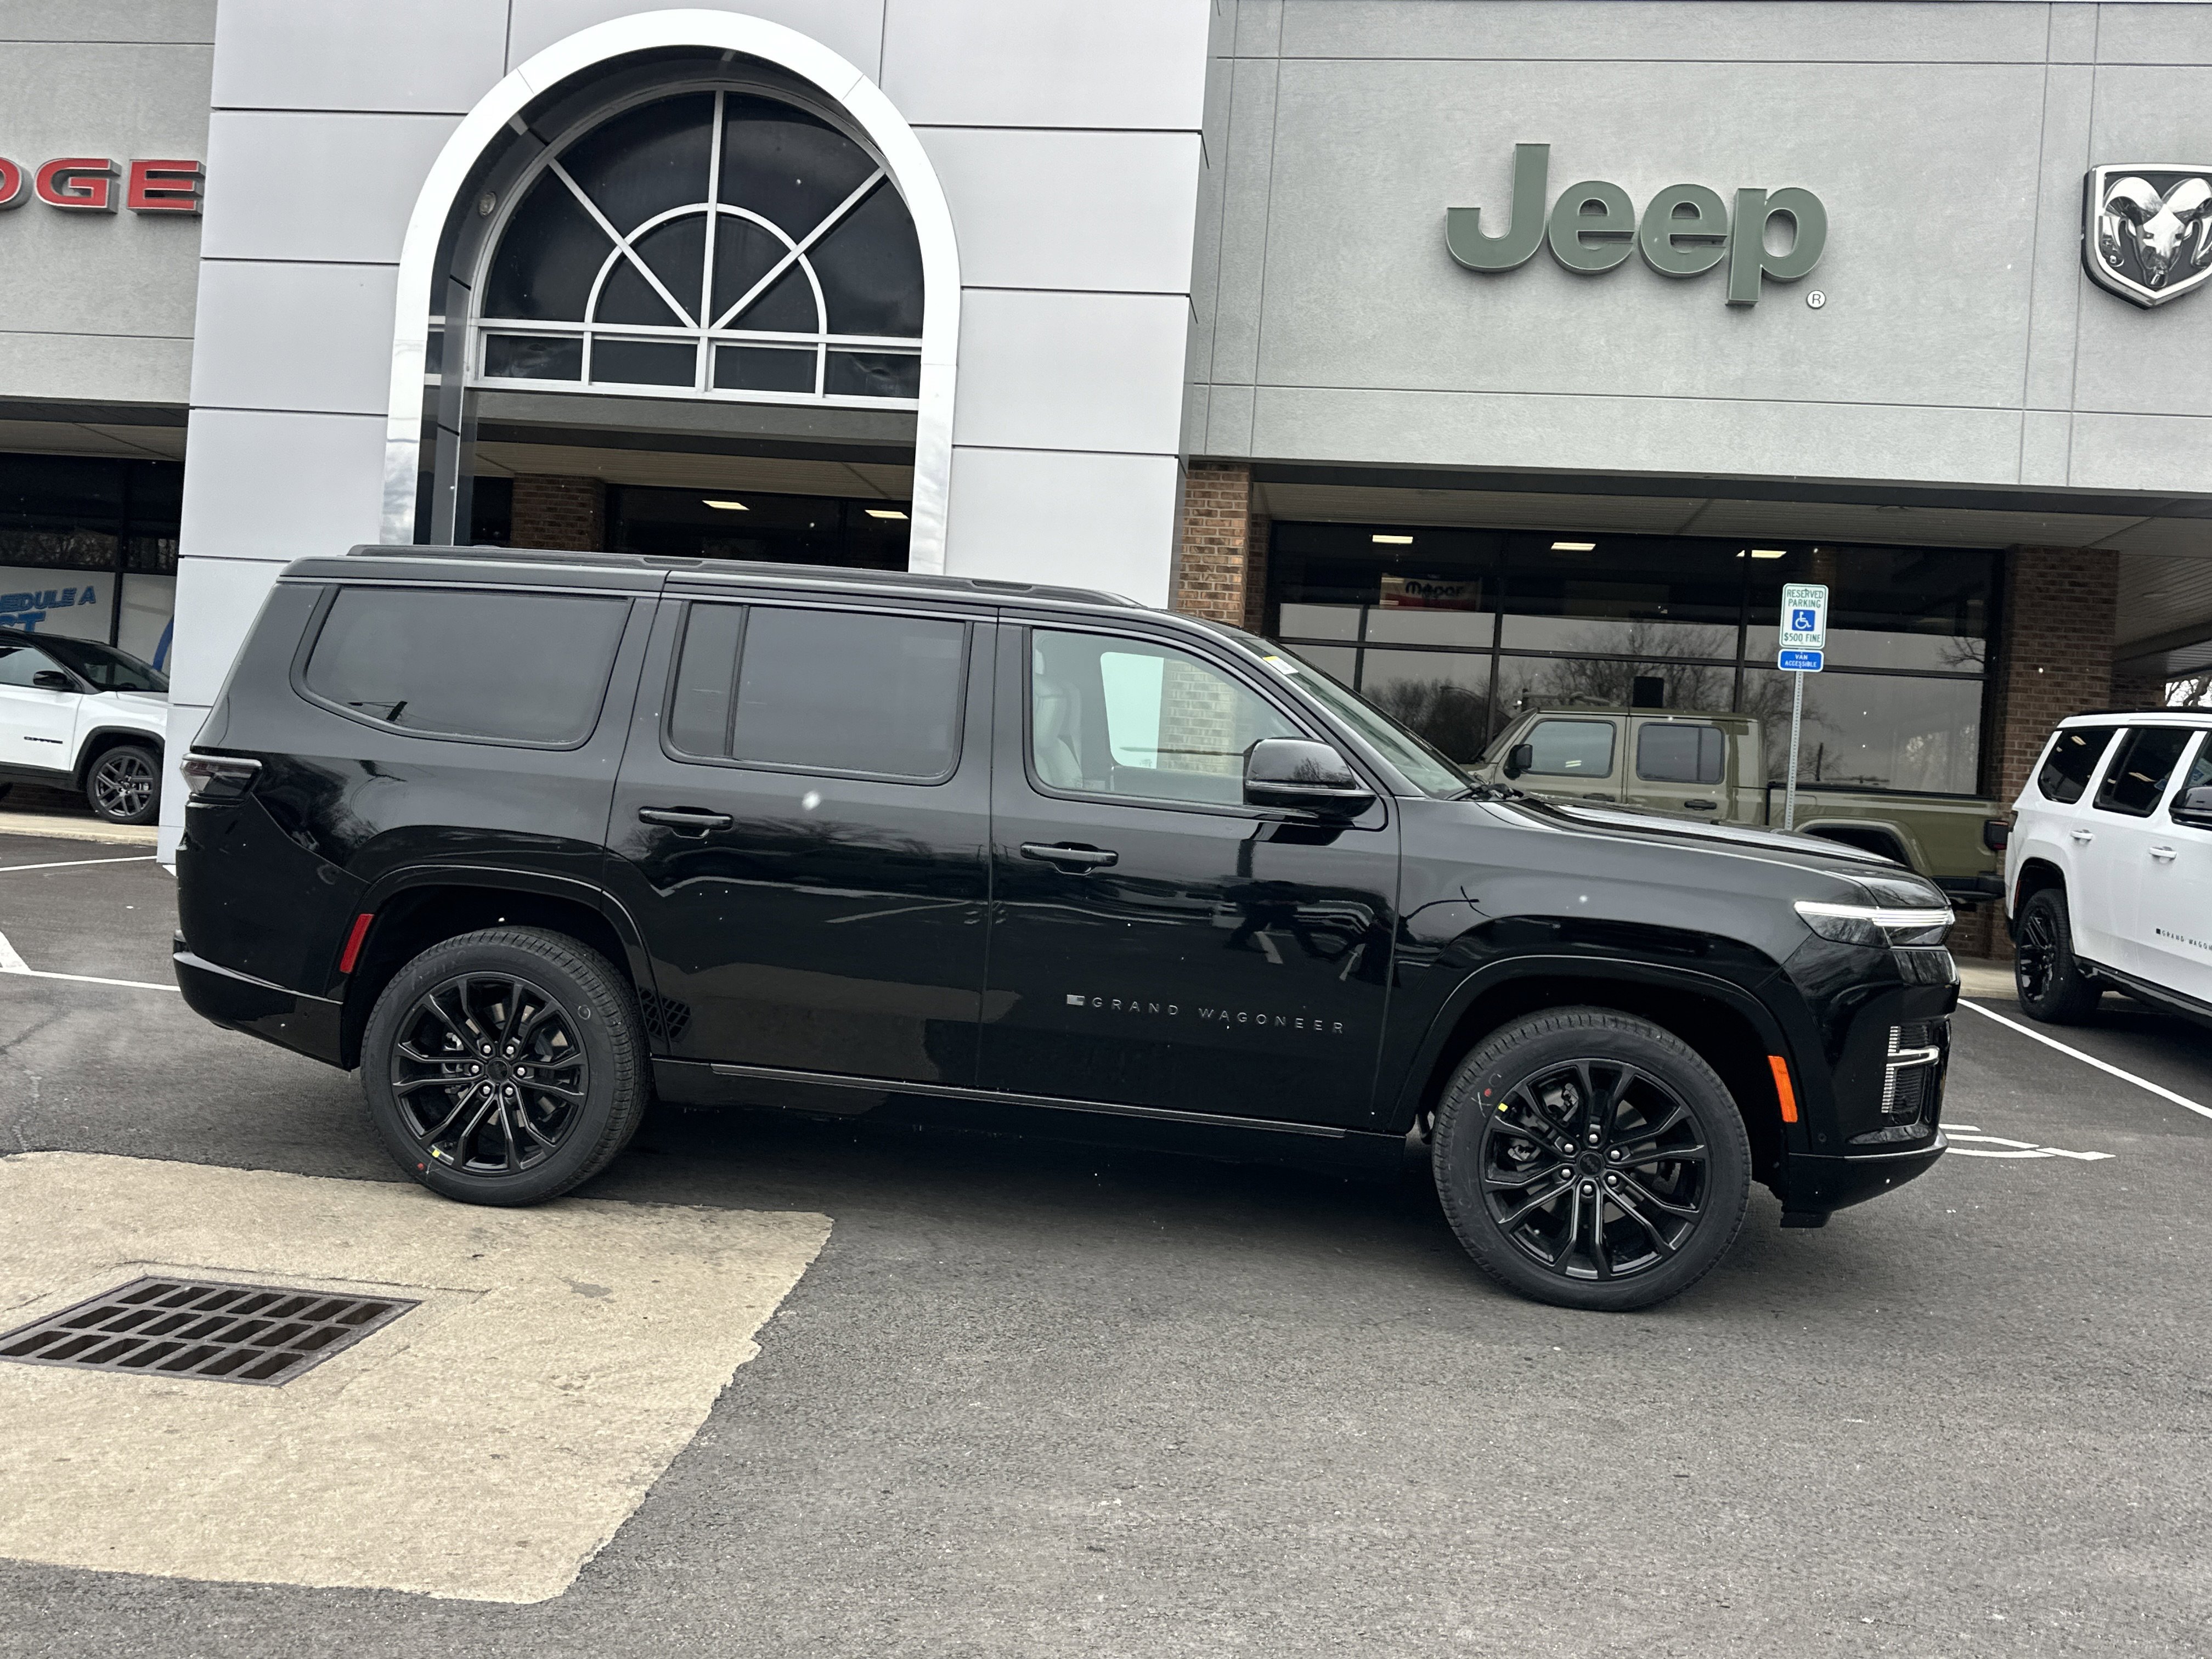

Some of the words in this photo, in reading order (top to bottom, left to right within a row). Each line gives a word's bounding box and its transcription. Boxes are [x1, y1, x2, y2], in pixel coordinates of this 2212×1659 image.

[0, 157, 203, 213] GE
[1444, 143, 1828, 305] Jeep
[78, 585, 96, 605] A
[1786, 589, 1824, 599] RESERVED
[1788, 599, 1821, 608] PARKING
[1784, 633, 1803, 642] $500
[1805, 633, 1821, 642] FINE
[1092, 996, 1179, 1016] GRAND
[1198, 1007, 1345, 1035] WAGONEER
